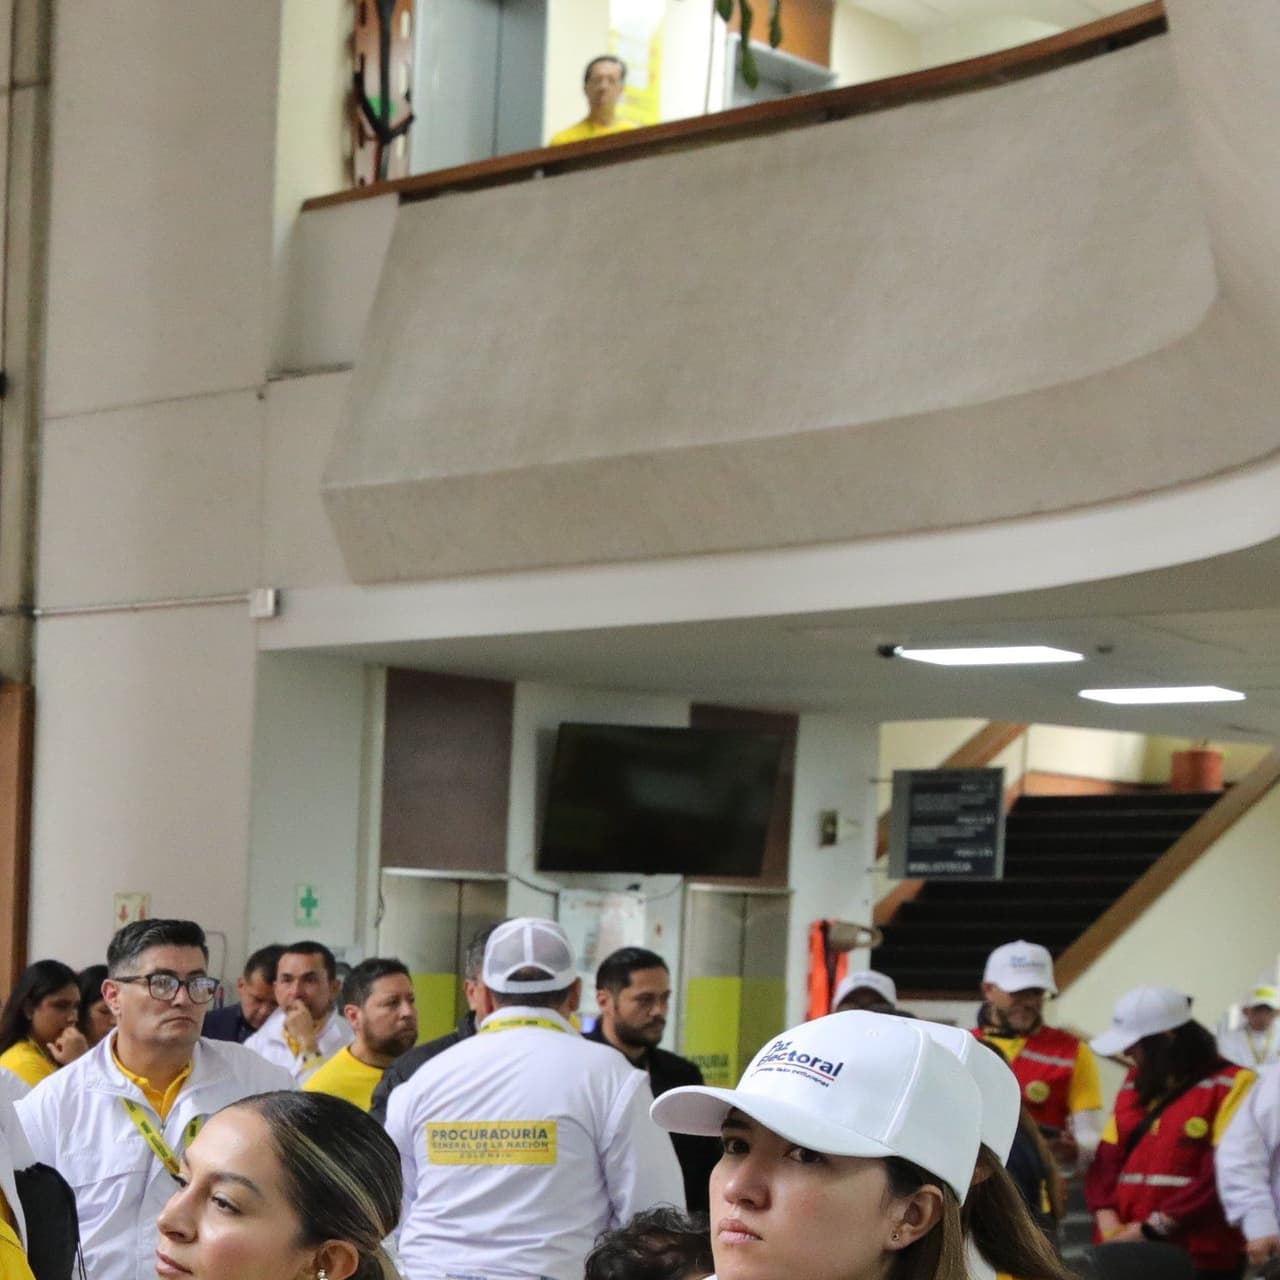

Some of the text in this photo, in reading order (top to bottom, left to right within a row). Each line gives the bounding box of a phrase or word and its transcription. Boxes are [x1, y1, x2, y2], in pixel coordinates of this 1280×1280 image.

[432, 1127, 548, 1141] PROCURADURÍA
[432, 1141, 472, 1149] GENERAL
[476, 1141, 488, 1149] DE
[490, 1141, 504, 1149] LA
